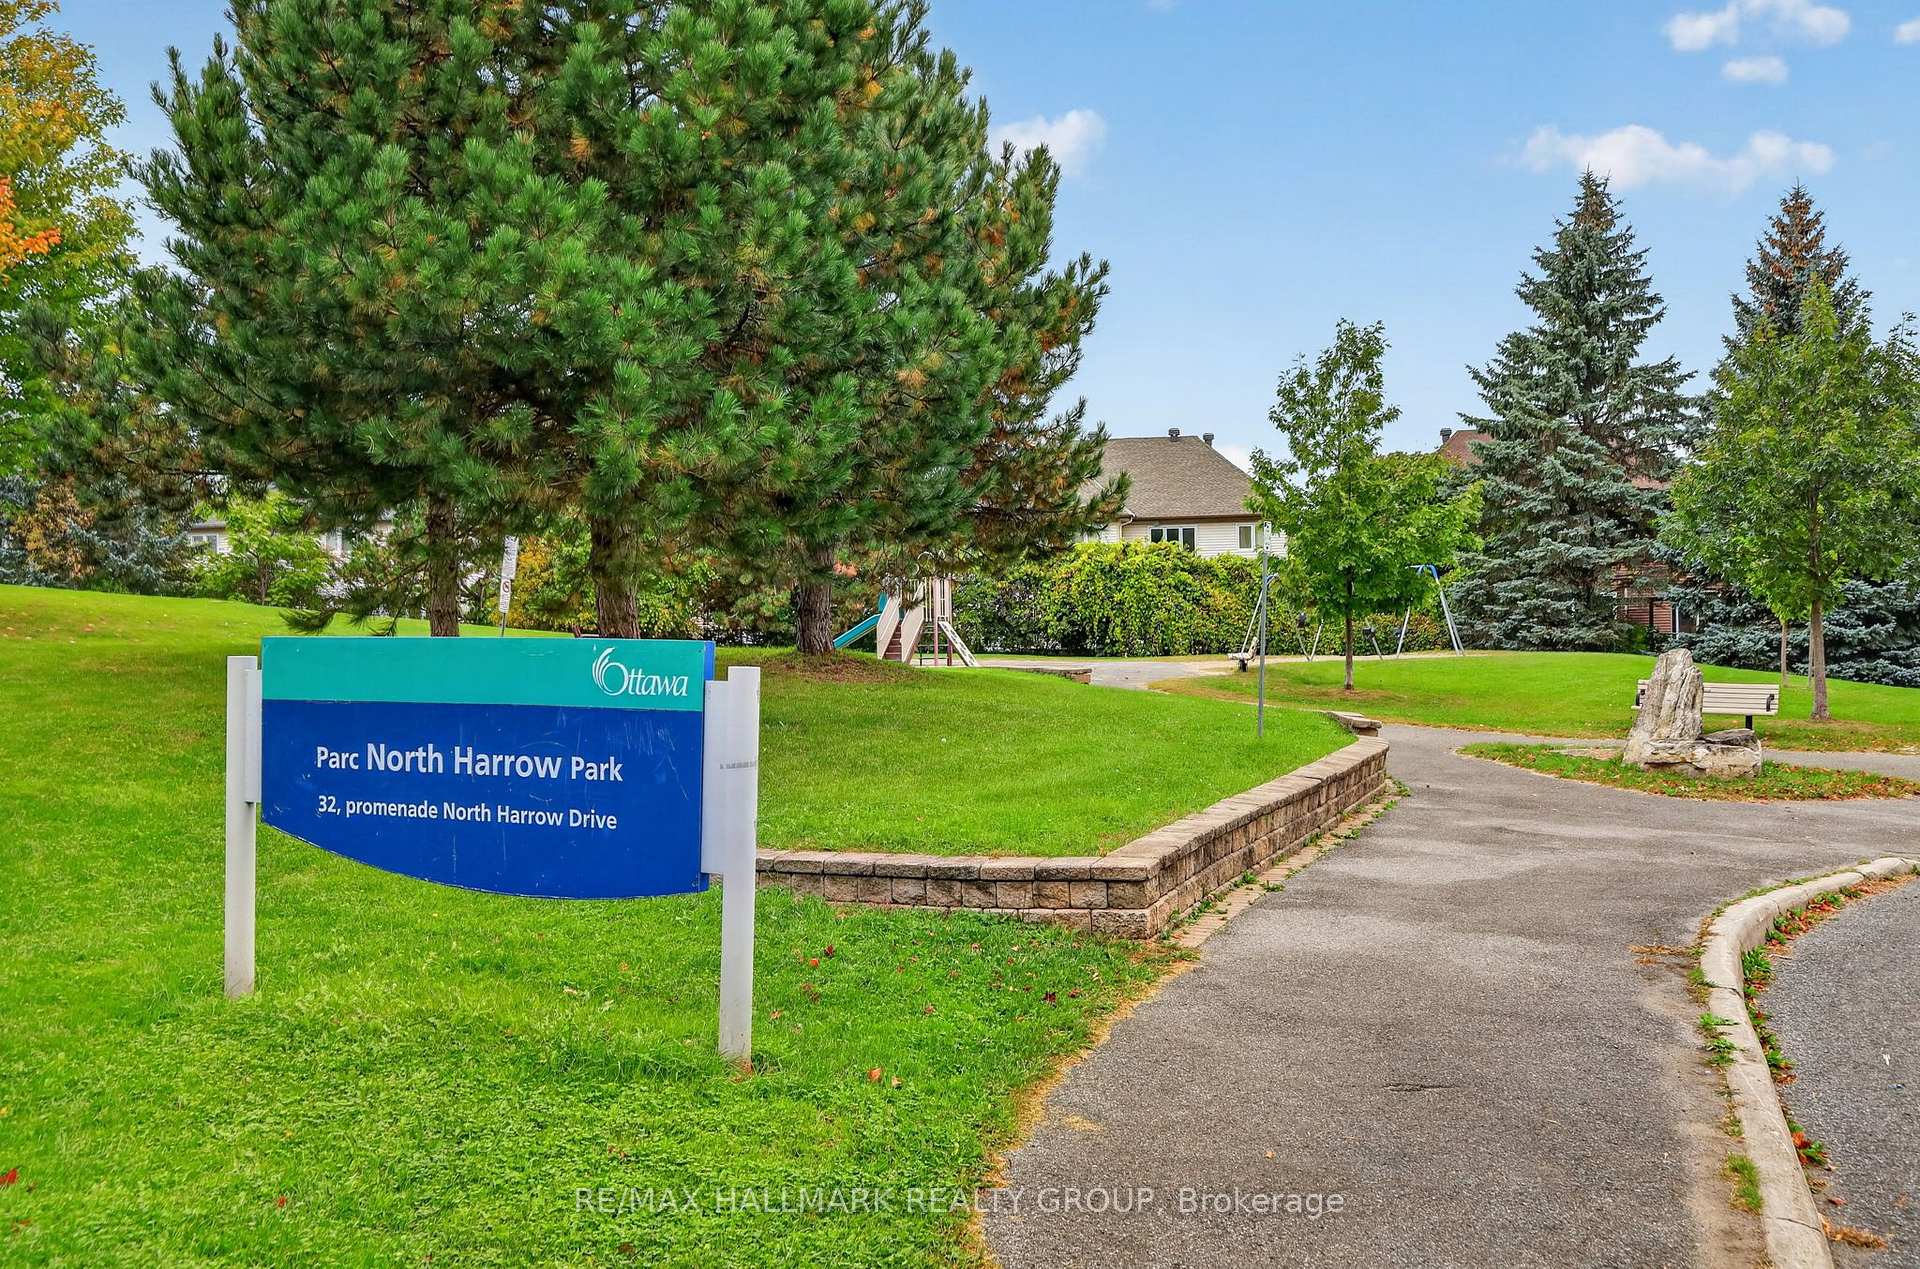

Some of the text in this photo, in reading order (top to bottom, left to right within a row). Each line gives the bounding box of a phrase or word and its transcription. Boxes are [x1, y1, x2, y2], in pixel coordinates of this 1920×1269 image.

[592, 647, 689, 697] Ottawa
[316, 743, 623, 783] Parc North Harrow Park
[318, 795, 618, 830] 32, promenade North Harrow Drive
